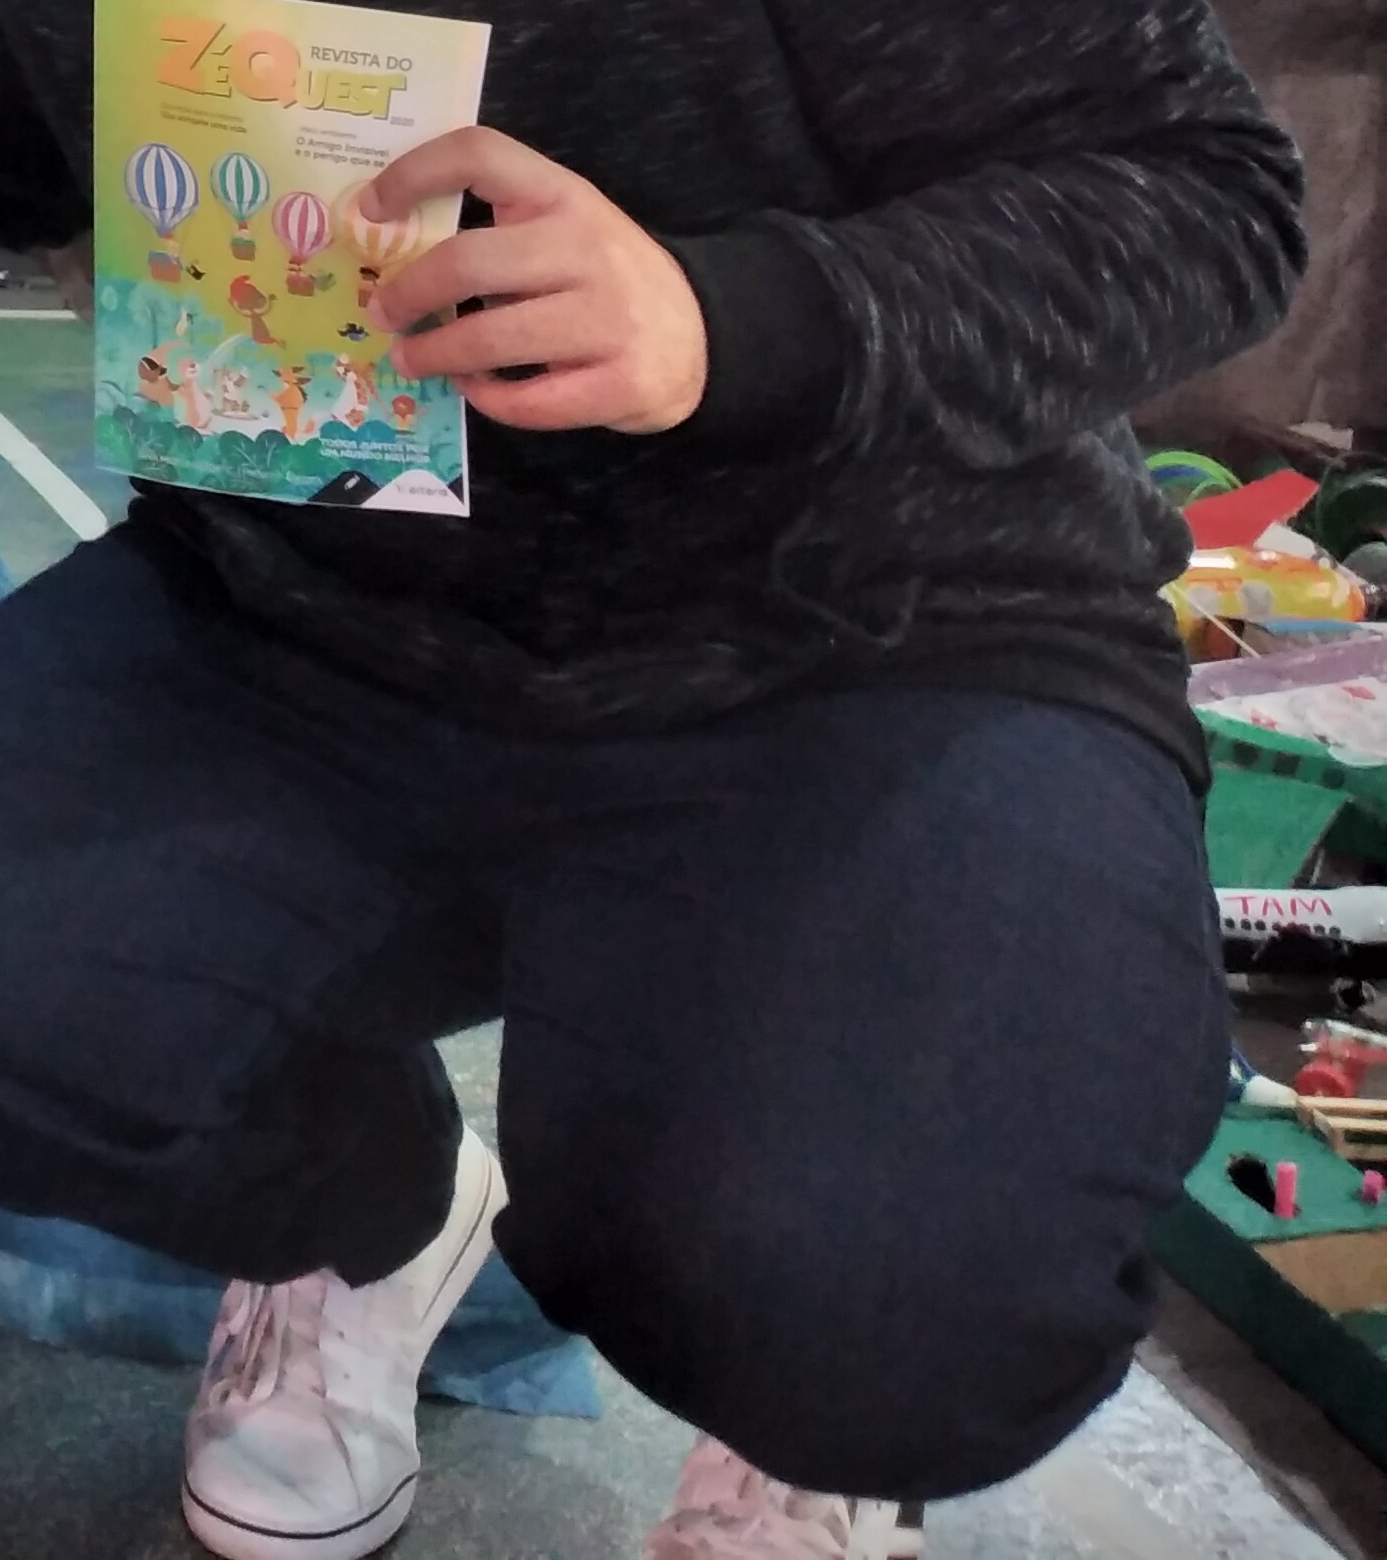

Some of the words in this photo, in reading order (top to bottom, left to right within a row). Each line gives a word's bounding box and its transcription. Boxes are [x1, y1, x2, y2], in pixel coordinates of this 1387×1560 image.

[310, 46, 381, 68] REVISTA
[386, 55, 413, 71] DO
[1224, 896, 1333, 916] TAM
